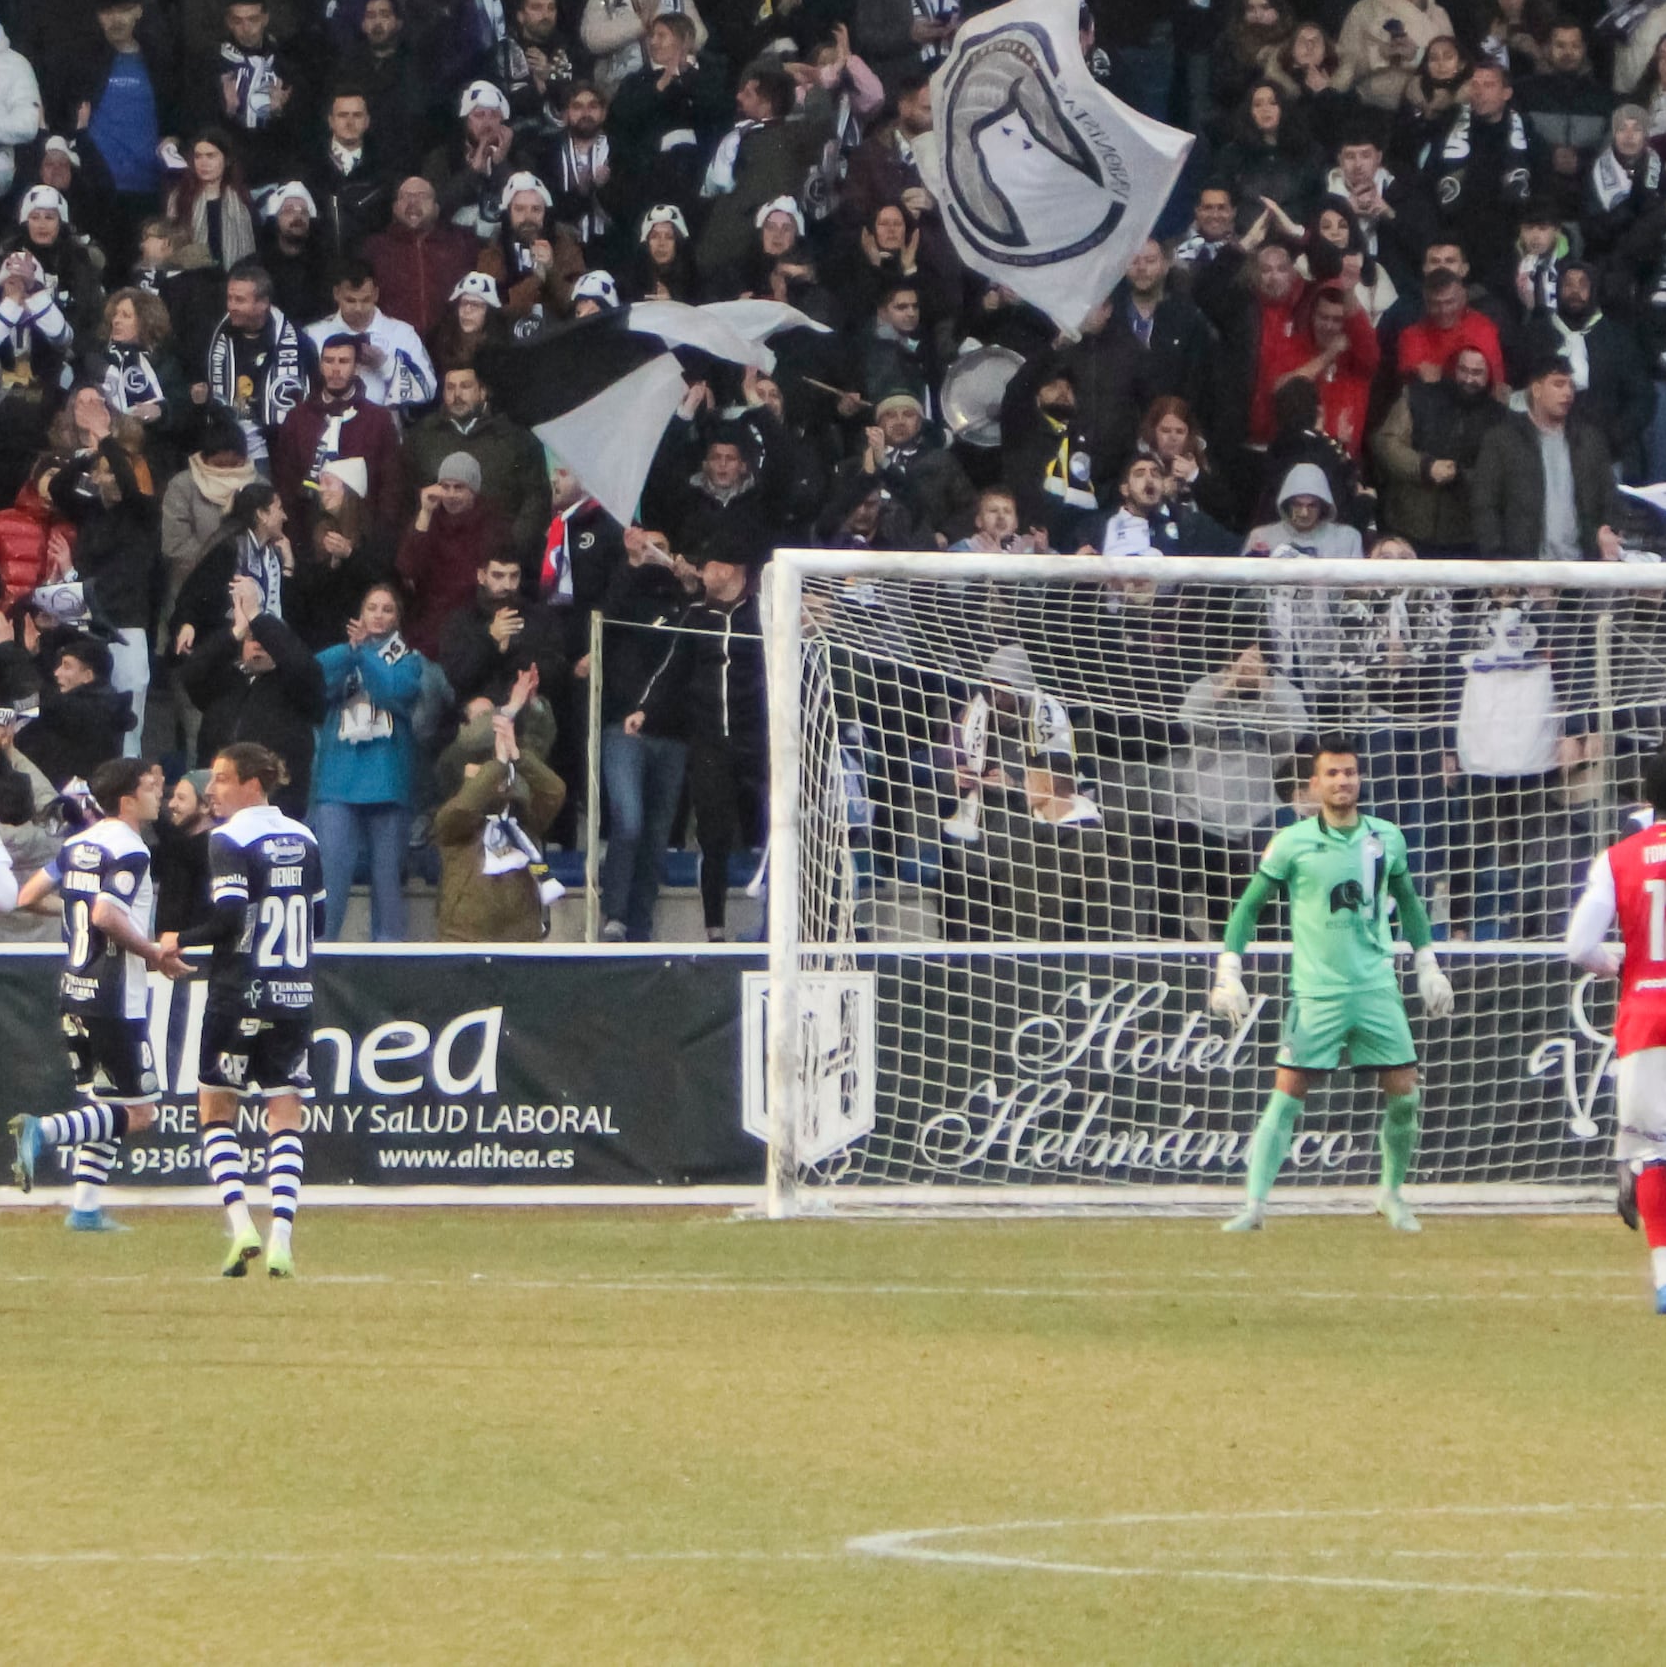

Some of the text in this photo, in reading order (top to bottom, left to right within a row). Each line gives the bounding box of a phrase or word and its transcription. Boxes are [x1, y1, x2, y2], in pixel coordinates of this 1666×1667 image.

[71, 900, 90, 968] 8
[257, 894, 309, 969] 20
[1011, 980, 1269, 1076] Hotel
[337, 1103, 363, 1134] Y
[476, 1104, 621, 1135] LABORAL
[921, 1079, 1360, 1171] Helmánco
[379, 1143, 575, 1170] www.althea.es
